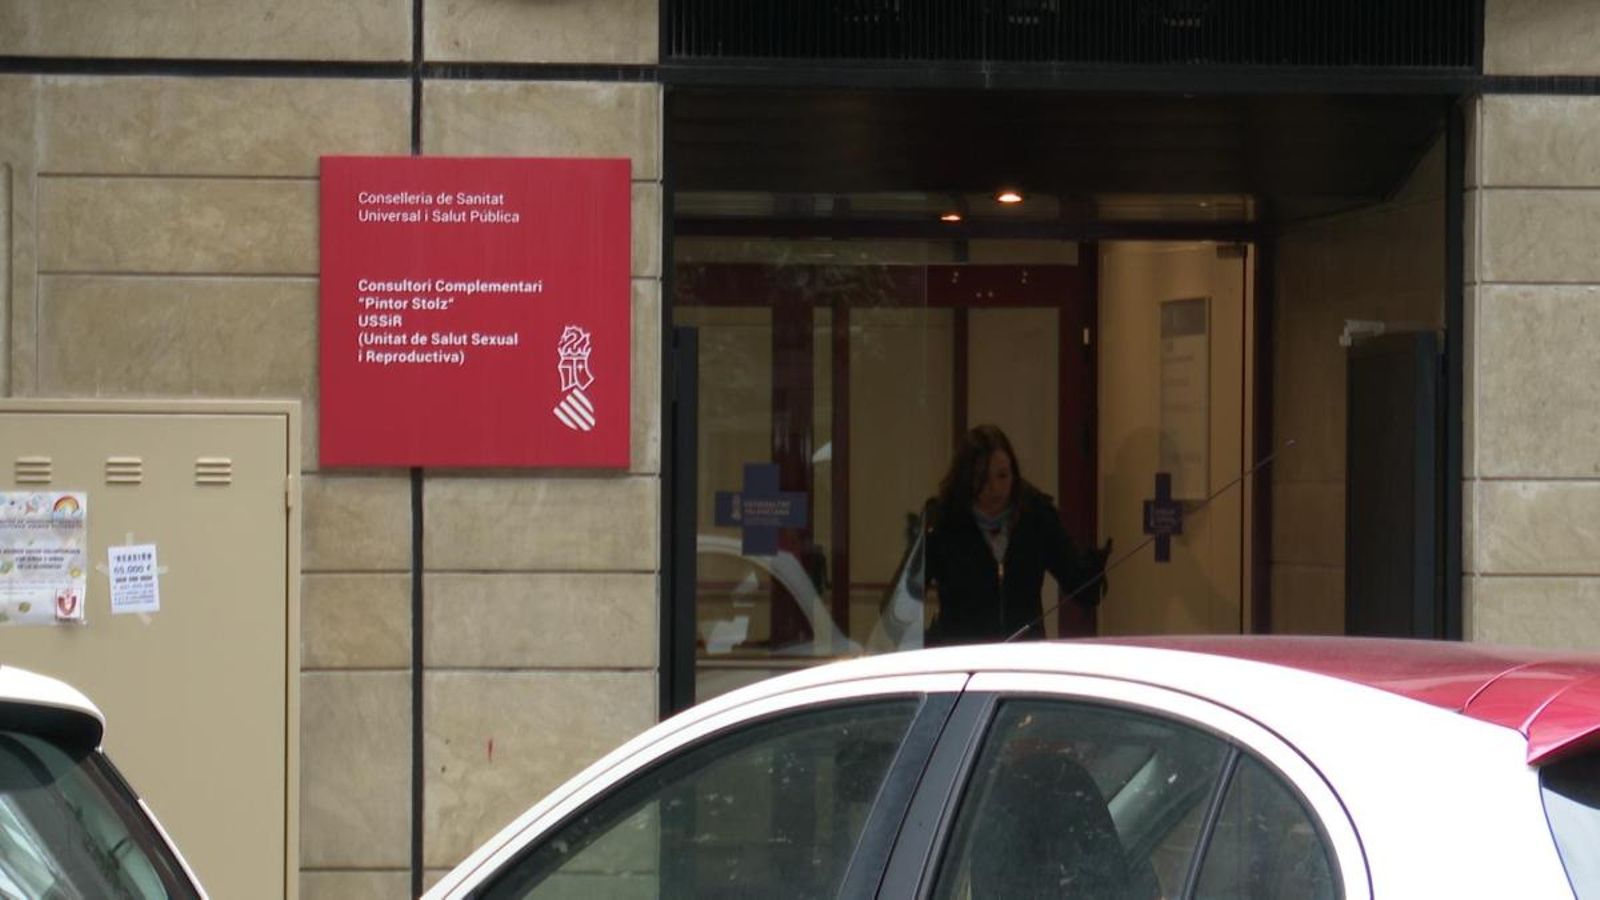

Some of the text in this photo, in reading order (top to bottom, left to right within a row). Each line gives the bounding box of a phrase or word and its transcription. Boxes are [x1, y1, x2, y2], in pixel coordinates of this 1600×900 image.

[358, 191, 504, 206] Conselleria de Sanitat
[358, 209, 421, 222] Universal
[431, 209, 467, 223] Salut
[471, 209, 520, 223] Pública
[358, 279, 543, 296] Consultori Complementari
[358, 314, 403, 327] USSiR
[358, 332, 519, 347] (Unitat de Salut Sexual
[358, 350, 465, 366] i Reproductiva)
